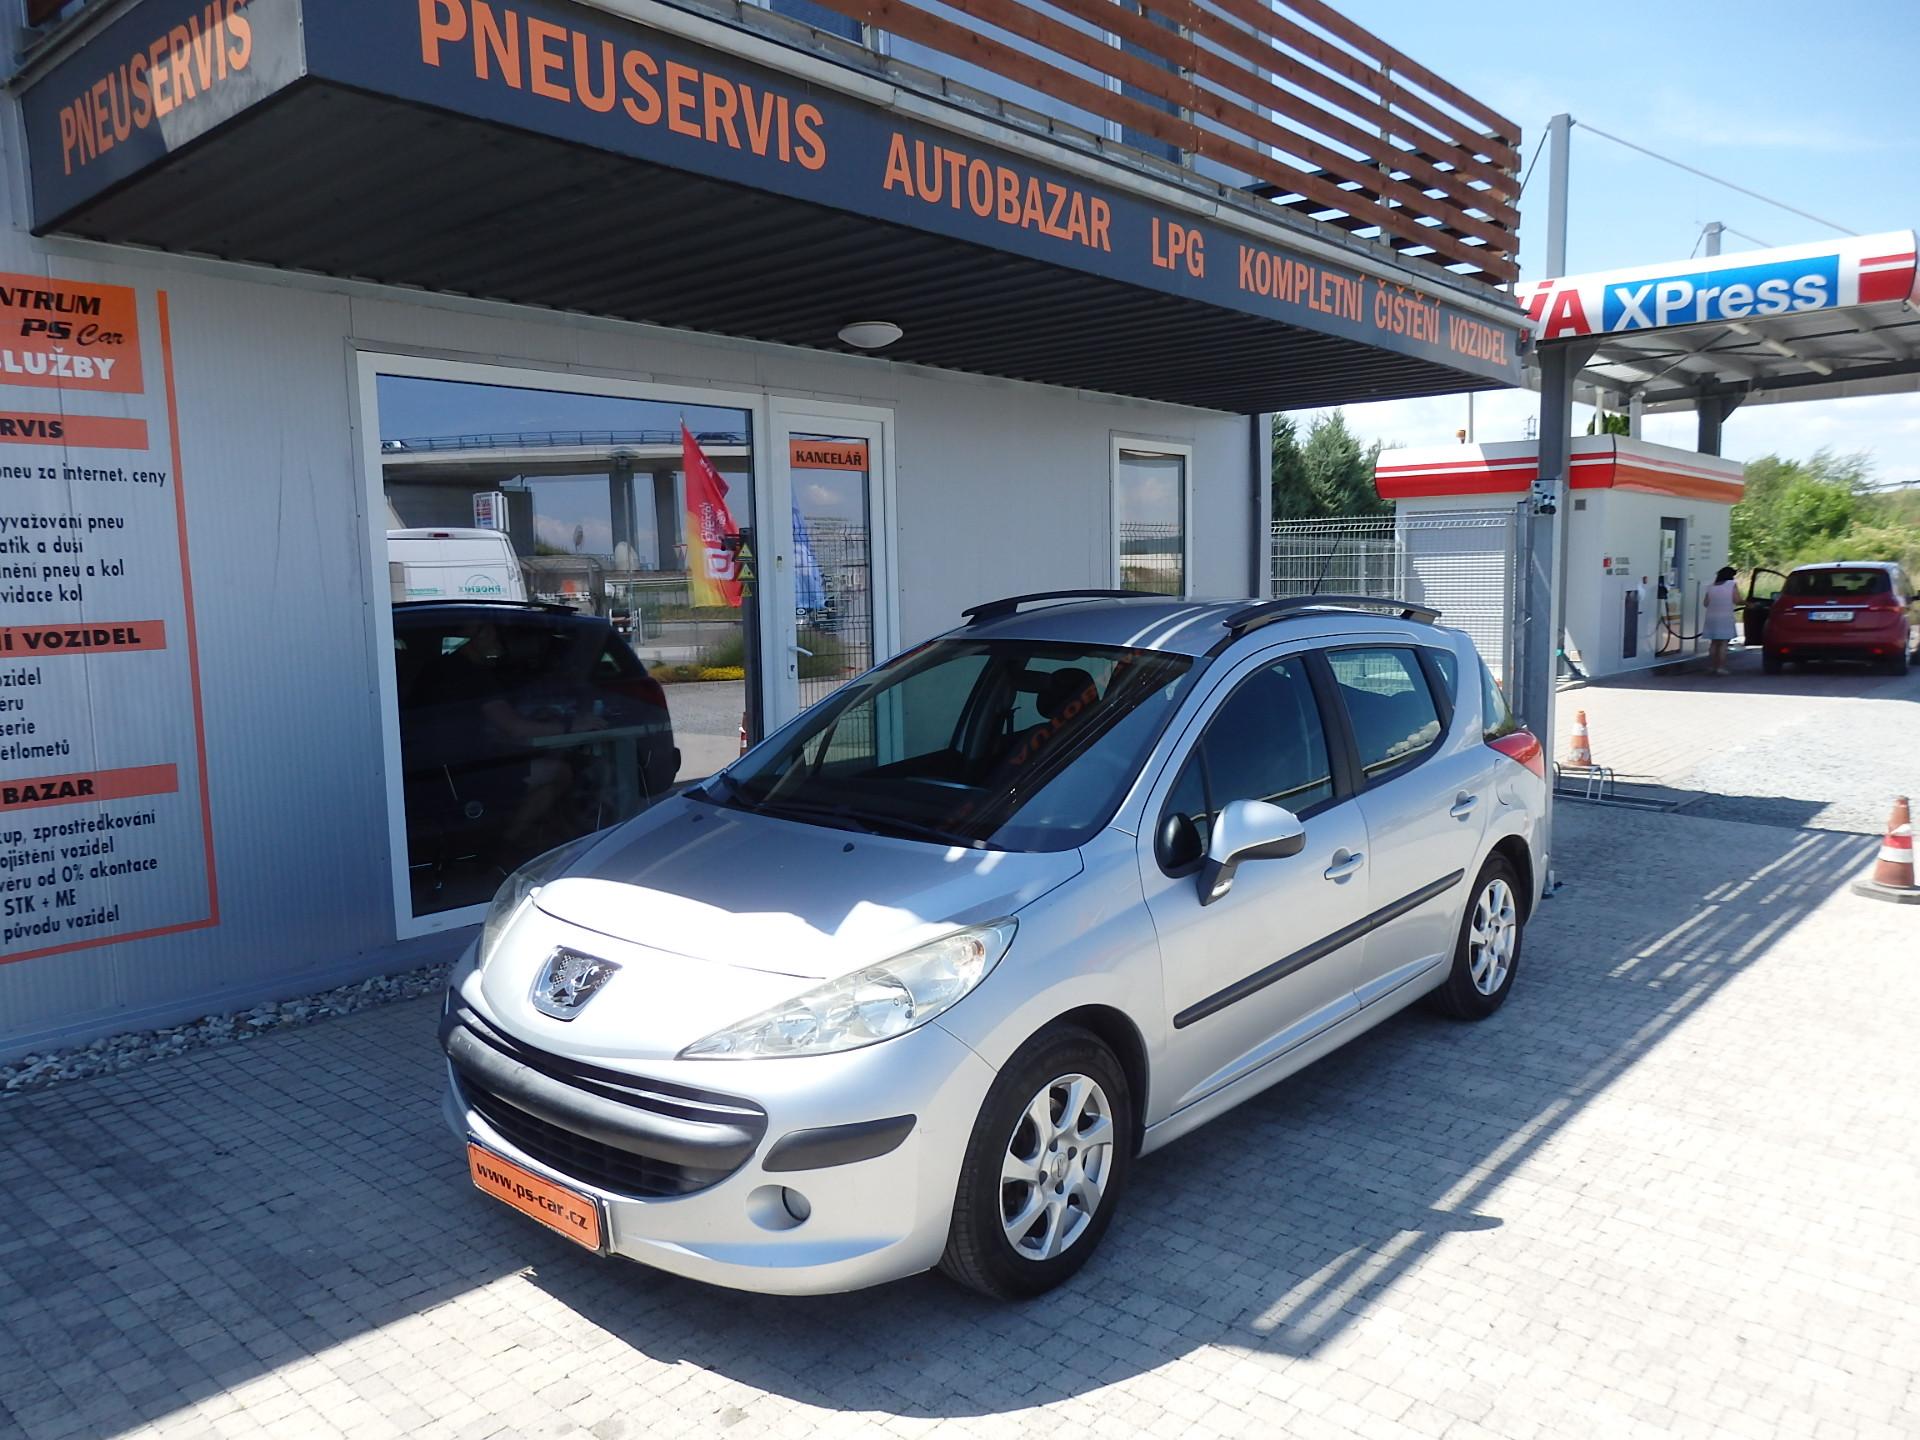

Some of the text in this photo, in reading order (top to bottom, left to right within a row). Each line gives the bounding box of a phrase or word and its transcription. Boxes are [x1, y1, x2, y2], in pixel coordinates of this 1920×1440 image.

[60, 0, 252, 176] PNEUSERVIS
[418, 0, 1508, 366] PNEUSERVIS AUTOBAZAR LPG KOMPLETNÍ ČIŠTĚNÍ VOZIDEL
[1611, 273, 1828, 331] XPress
[21, 318, 125, 346] PS Car
[0, 345, 115, 381] LUŽBY
[796, 450, 861, 466] KANCELÁŘ
[38, 467, 56, 479] za
[62, 461, 128, 482] internet.
[133, 471, 166, 487] ceny
[88, 517, 124, 533] pneu
[37, 541, 46, 553] a
[43, 565, 80, 582] pneu
[86, 565, 96, 577] a
[100, 558, 125, 577] kol
[58, 583, 83, 602] kol
[22, 628, 141, 650] VOZIDEL
[2, 778, 95, 805] BAZAR
[33, 809, 156, 843] zprostředkování
[60, 835, 114, 859] vozidel
[37, 867, 56, 887] od
[61, 863, 84, 883] 0%
[90, 858, 157, 879] akontace
[4, 895, 36, 917] STK
[55, 888, 77, 908] ME
[4, 904, 120, 944] původu vozidel
[476, 1162, 588, 1230] www.ps-car.cz
